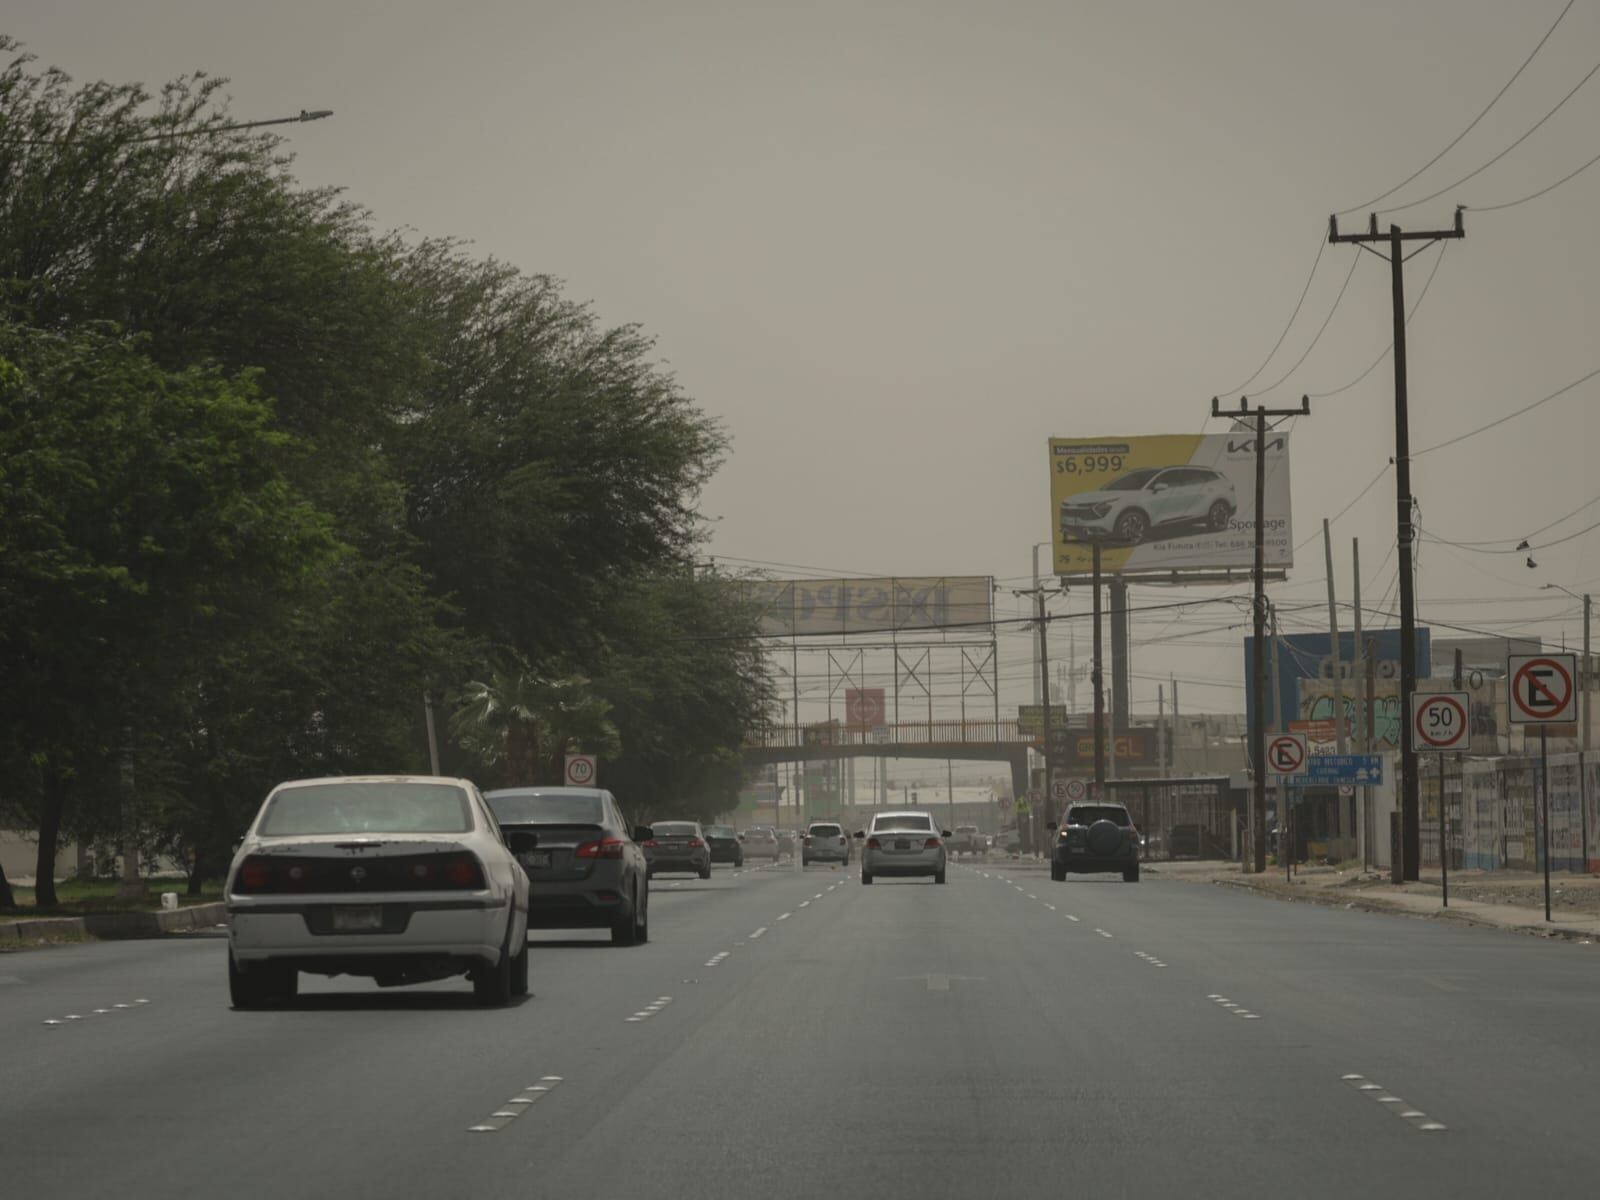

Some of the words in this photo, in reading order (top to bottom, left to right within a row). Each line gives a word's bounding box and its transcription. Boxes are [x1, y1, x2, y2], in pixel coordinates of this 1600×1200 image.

[1230, 518, 1285, 532] Sporage
[1528, 670, 1556, 706] E
[1429, 707, 1452, 727] 50
[575, 763, 587, 774] 70
